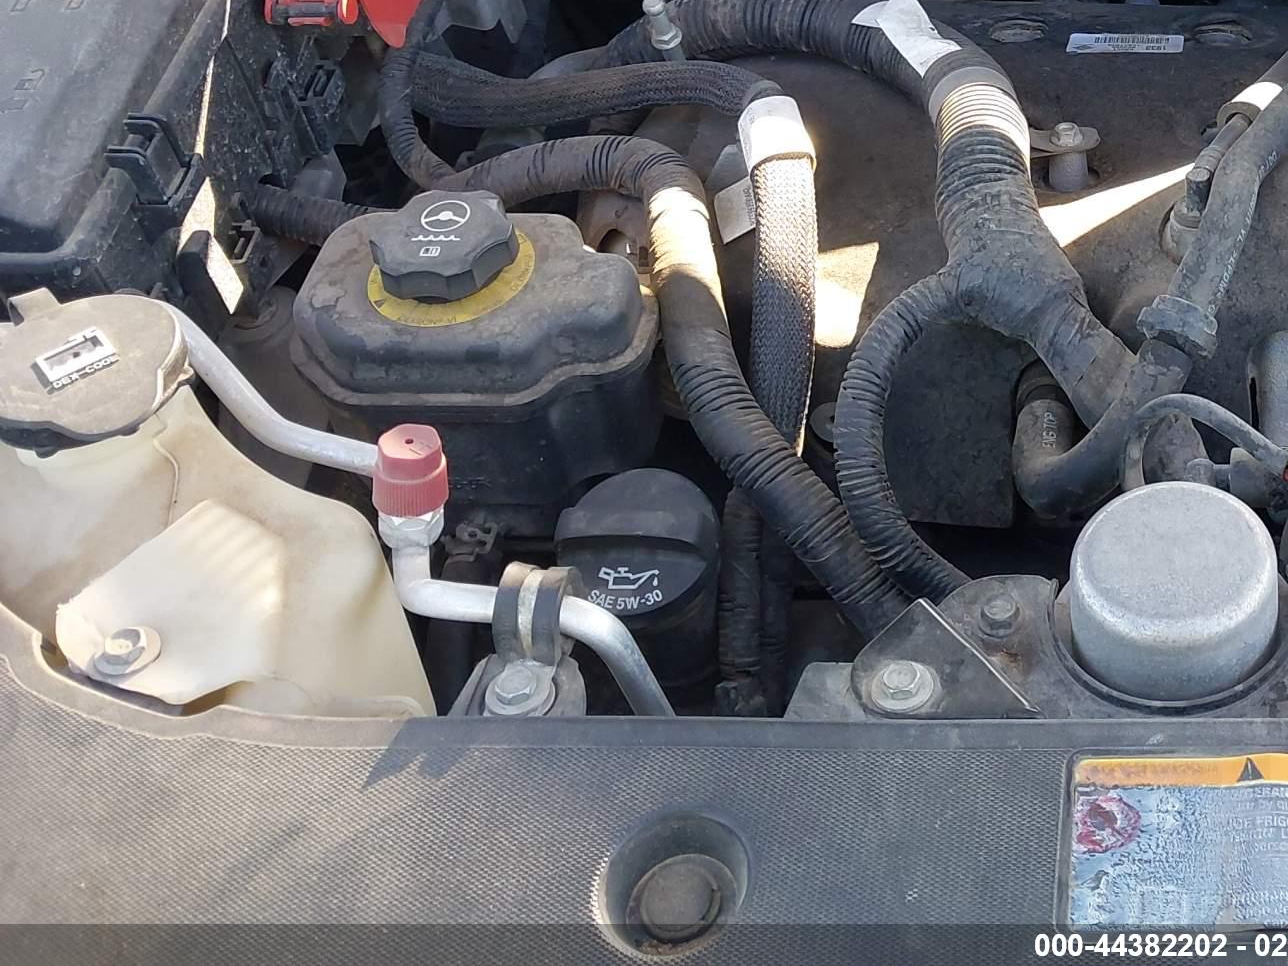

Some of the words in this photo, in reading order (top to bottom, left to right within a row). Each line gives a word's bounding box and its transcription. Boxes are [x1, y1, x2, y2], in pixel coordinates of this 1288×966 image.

[1042, 412, 1057, 429] TOP
[587, 590, 616, 609] SAE
[616, 589, 663, 610] 5W-30
